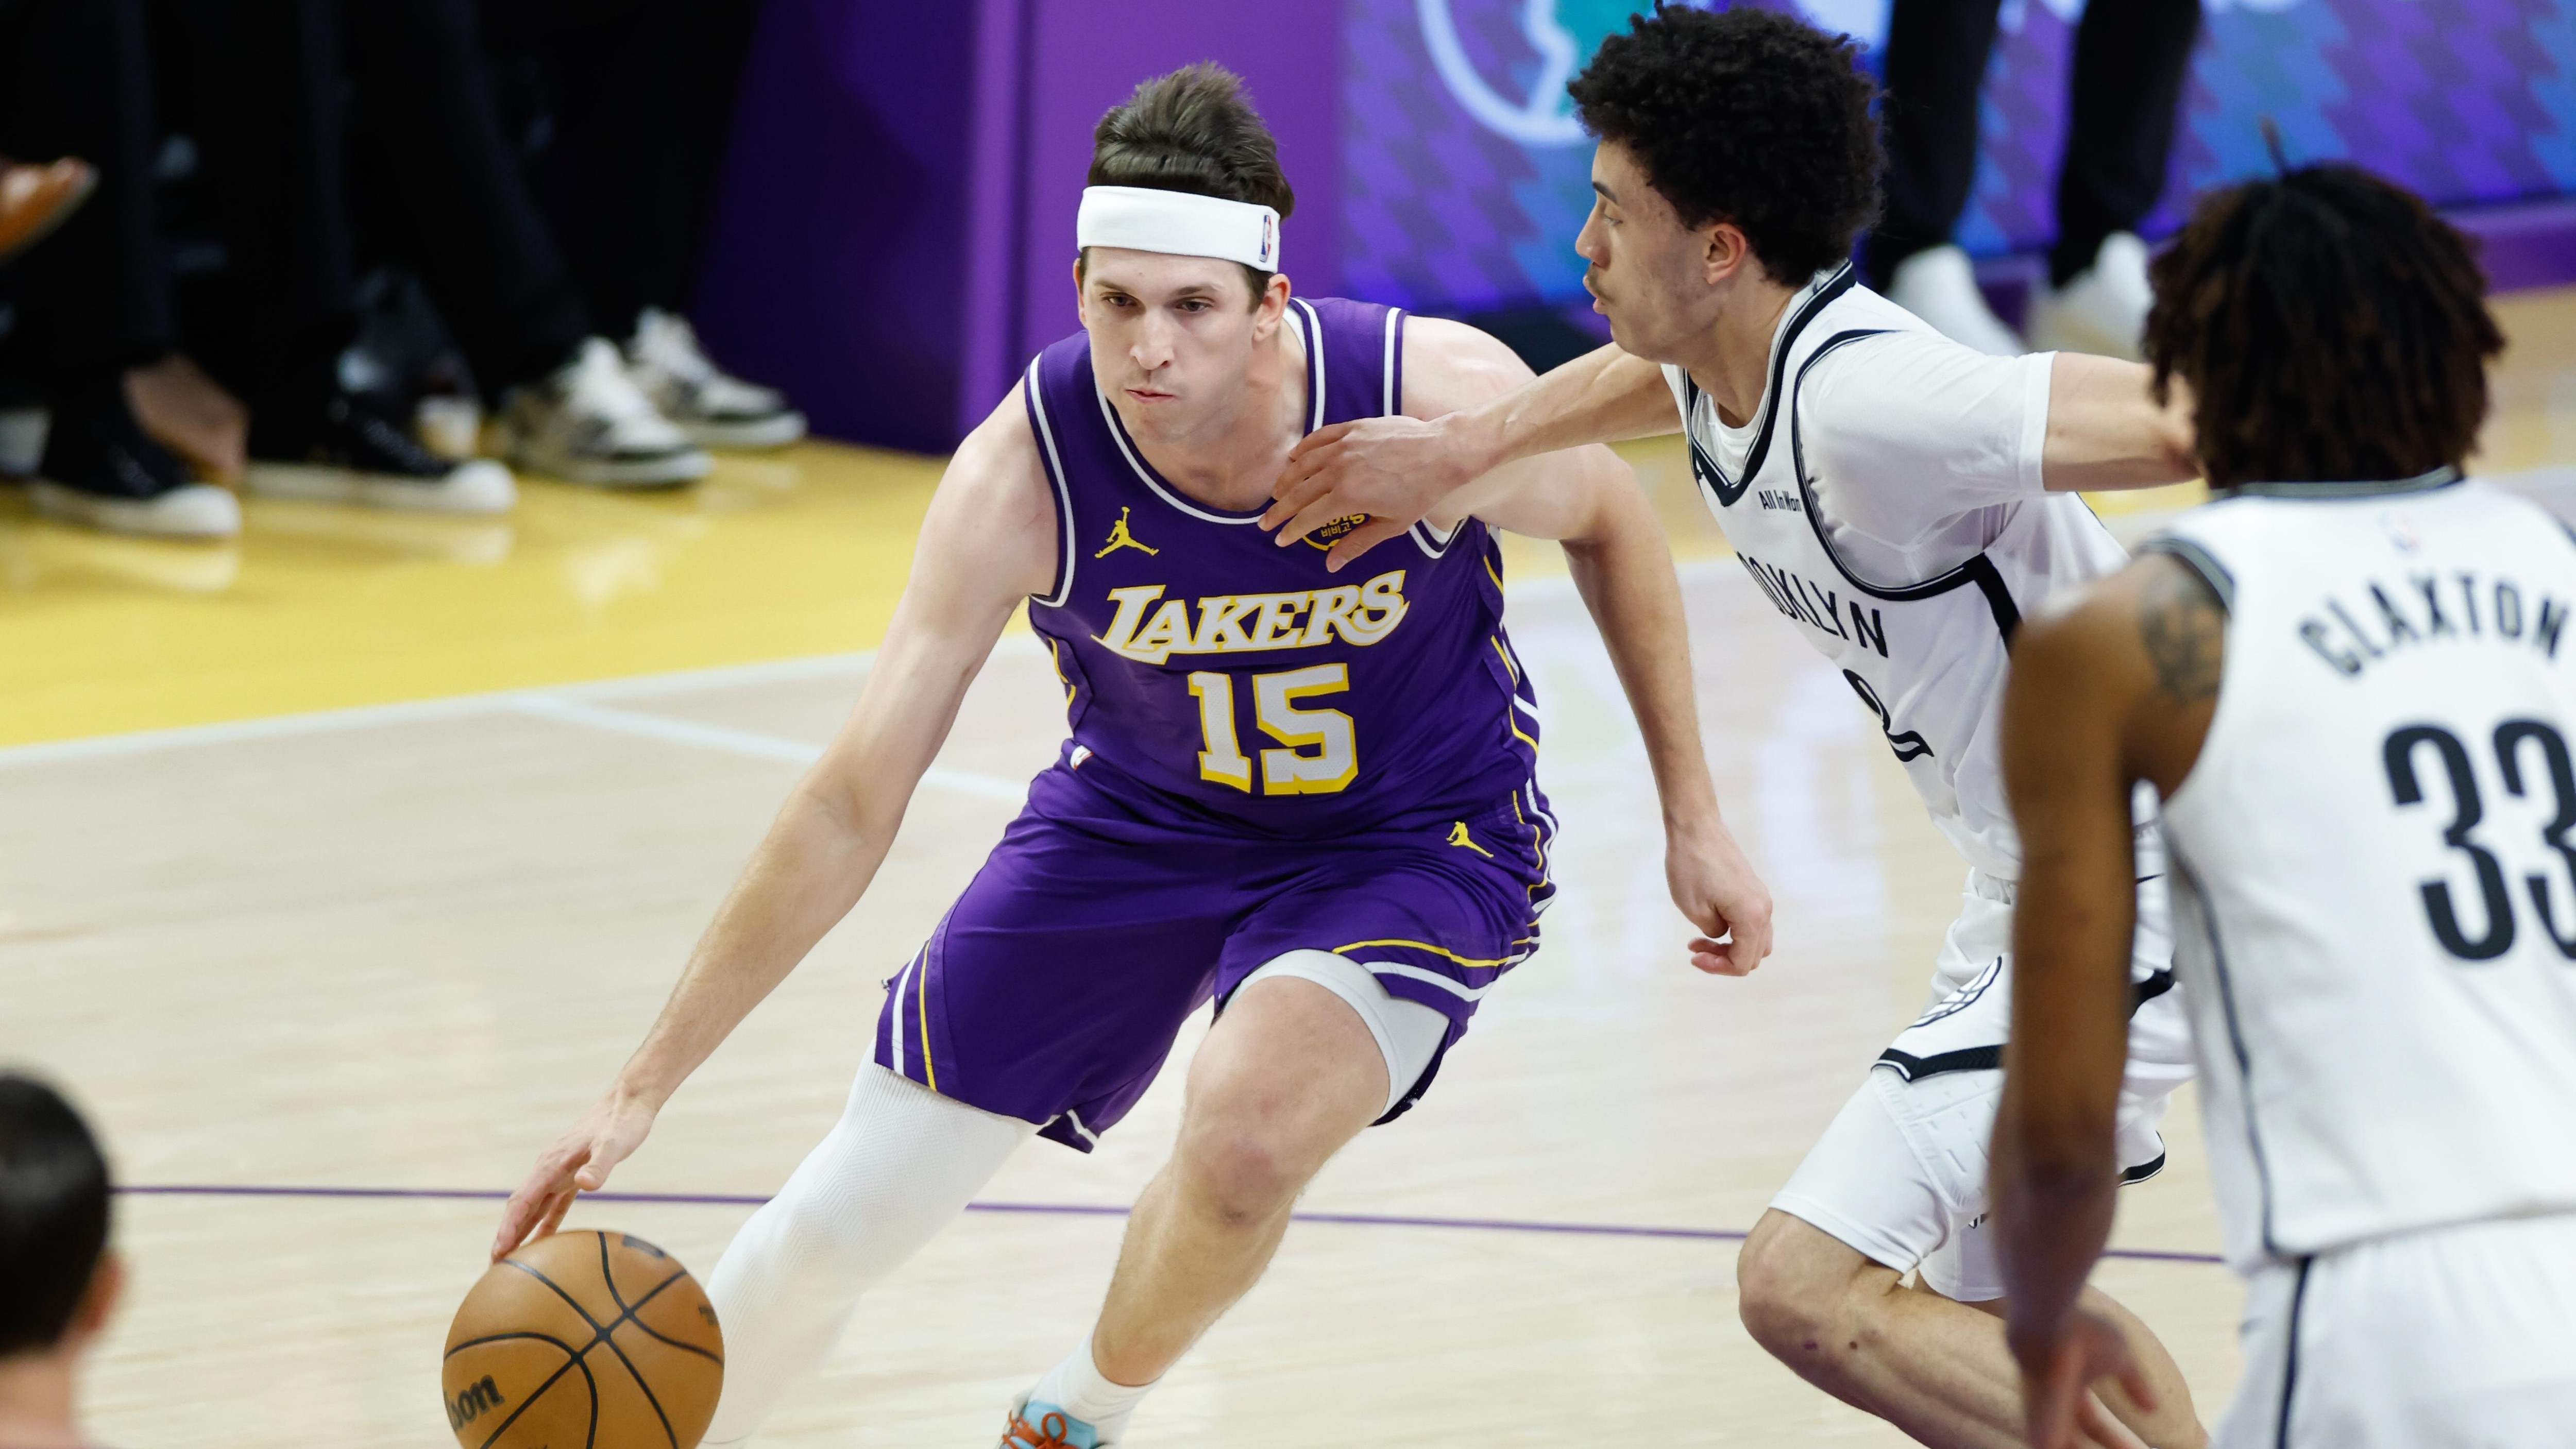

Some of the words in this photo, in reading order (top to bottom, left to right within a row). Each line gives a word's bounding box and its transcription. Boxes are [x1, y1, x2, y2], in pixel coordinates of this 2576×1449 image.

[1758, 490, 1777, 509] All
[1091, 570, 1411, 665] LAKERS
[2298, 569, 2569, 676] CLAXTON
[1188, 662, 1359, 796] 15
[2382, 721, 2576, 962] 33
[444, 1374, 505, 1433] son
